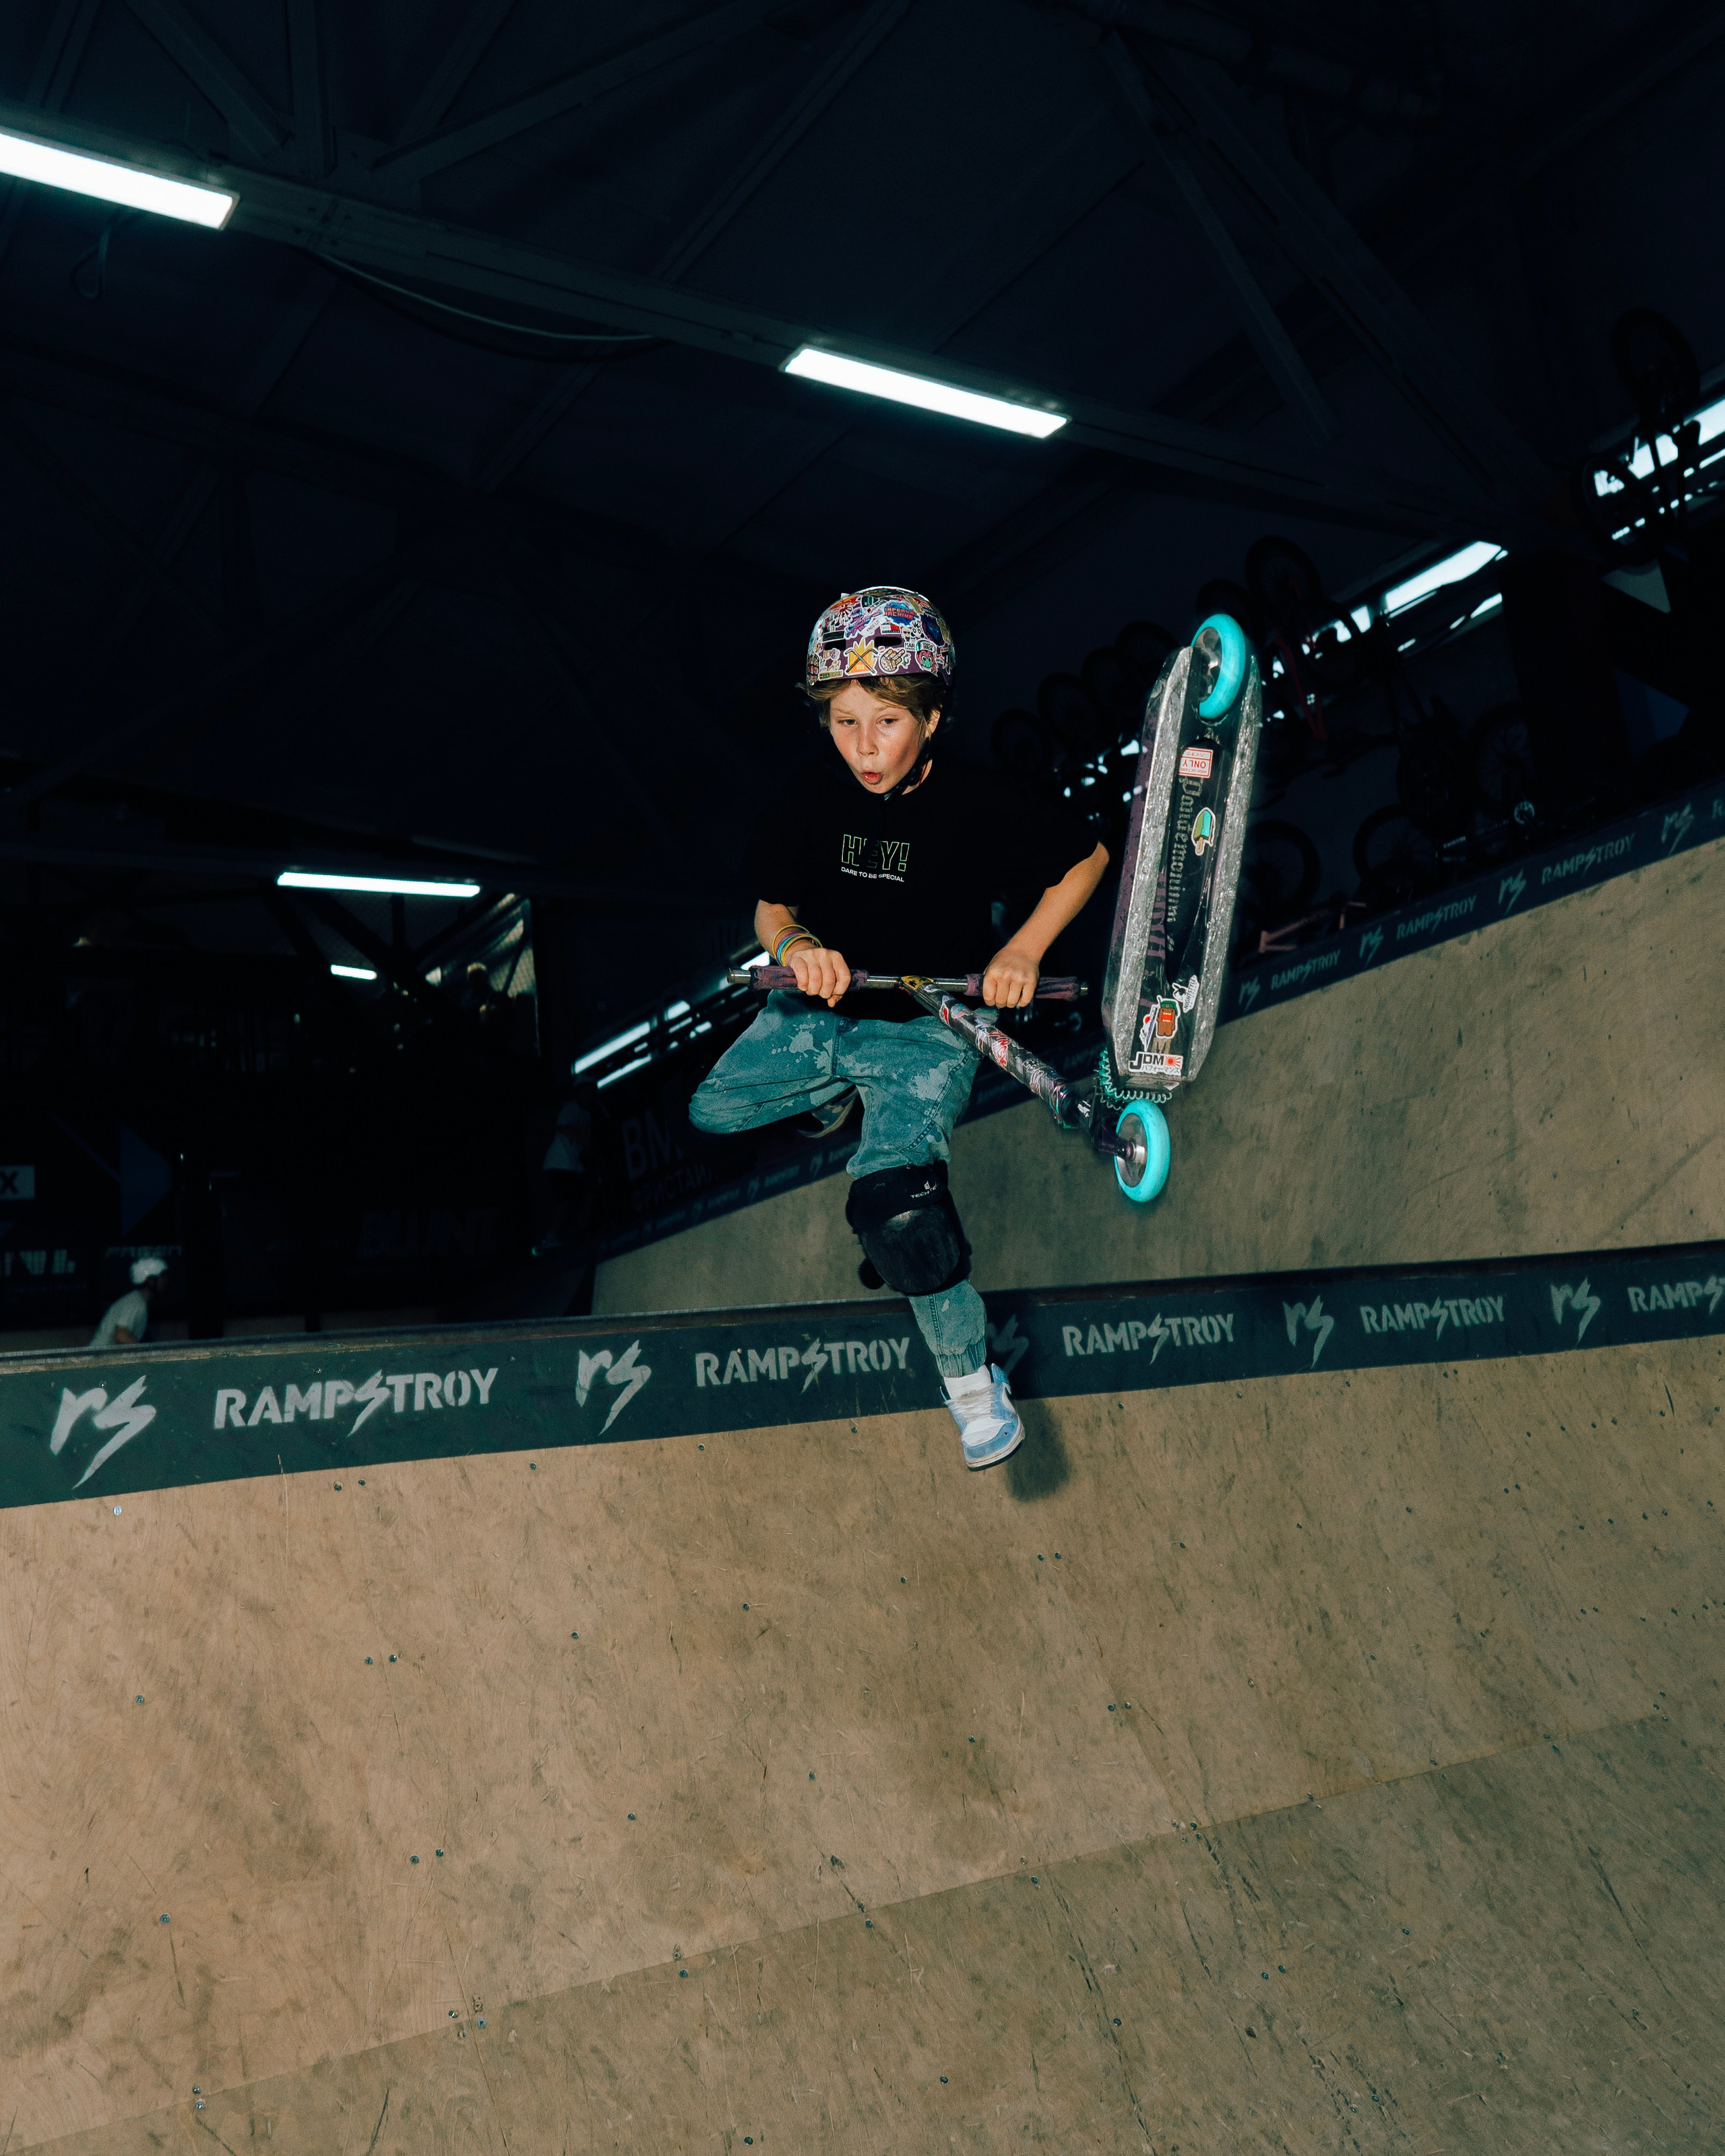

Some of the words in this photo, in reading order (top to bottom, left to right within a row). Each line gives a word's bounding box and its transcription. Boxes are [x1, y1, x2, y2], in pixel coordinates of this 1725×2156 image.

[1183, 759, 1207, 769] ONLY
[841, 866, 858, 876] DARE
[878, 873, 905, 882] SPECIAL
[1542, 833, 1637, 885] RAMPSTROY
[1396, 895, 1478, 940] RAMPSTROY
[1269, 948, 1341, 991] RAMPSTROY
[1184, 978, 1196, 1009] NIGHTSTYLE
[1129, 1053, 1164, 1070] JDM
[621, 1107, 687, 1180] BM
[910, 1190, 930, 1199] TECH
[213, 1368, 499, 1437] RAMPSTROY
[695, 1337, 910, 1393] RAMPSTROY
[1061, 1312, 1234, 1365] RAMPSTROY
[1359, 1295, 1505, 1341] RAMPSTROY
